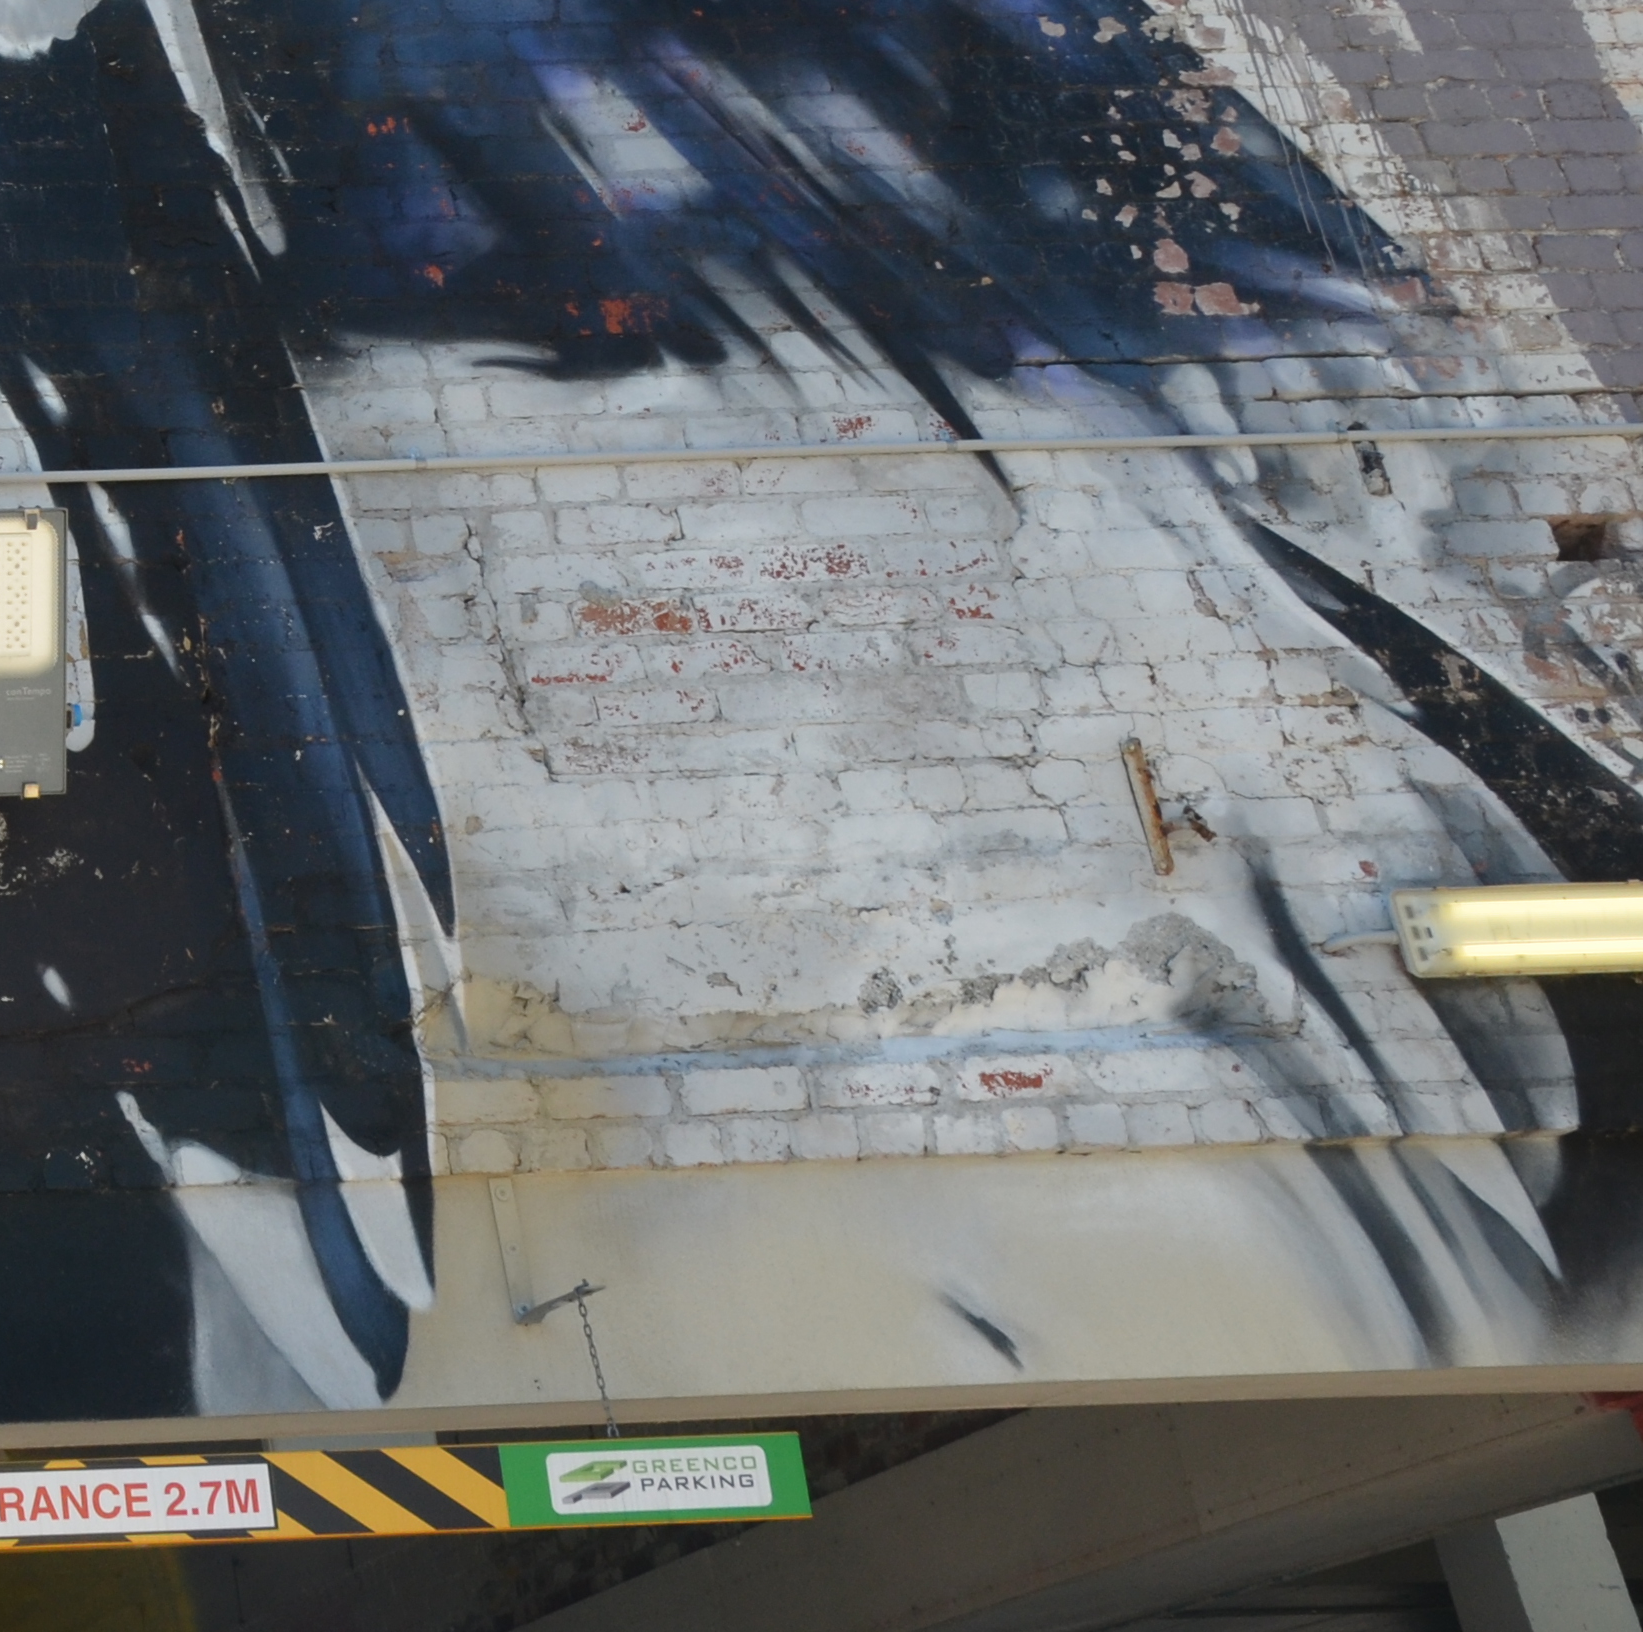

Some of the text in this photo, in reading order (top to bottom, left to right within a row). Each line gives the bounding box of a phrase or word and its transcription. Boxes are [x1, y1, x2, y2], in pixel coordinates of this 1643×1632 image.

[632, 1455, 757, 1474] GREENCO
[640, 1473, 755, 1492] PARKING
[163, 1477, 260, 1517] 2.7M
